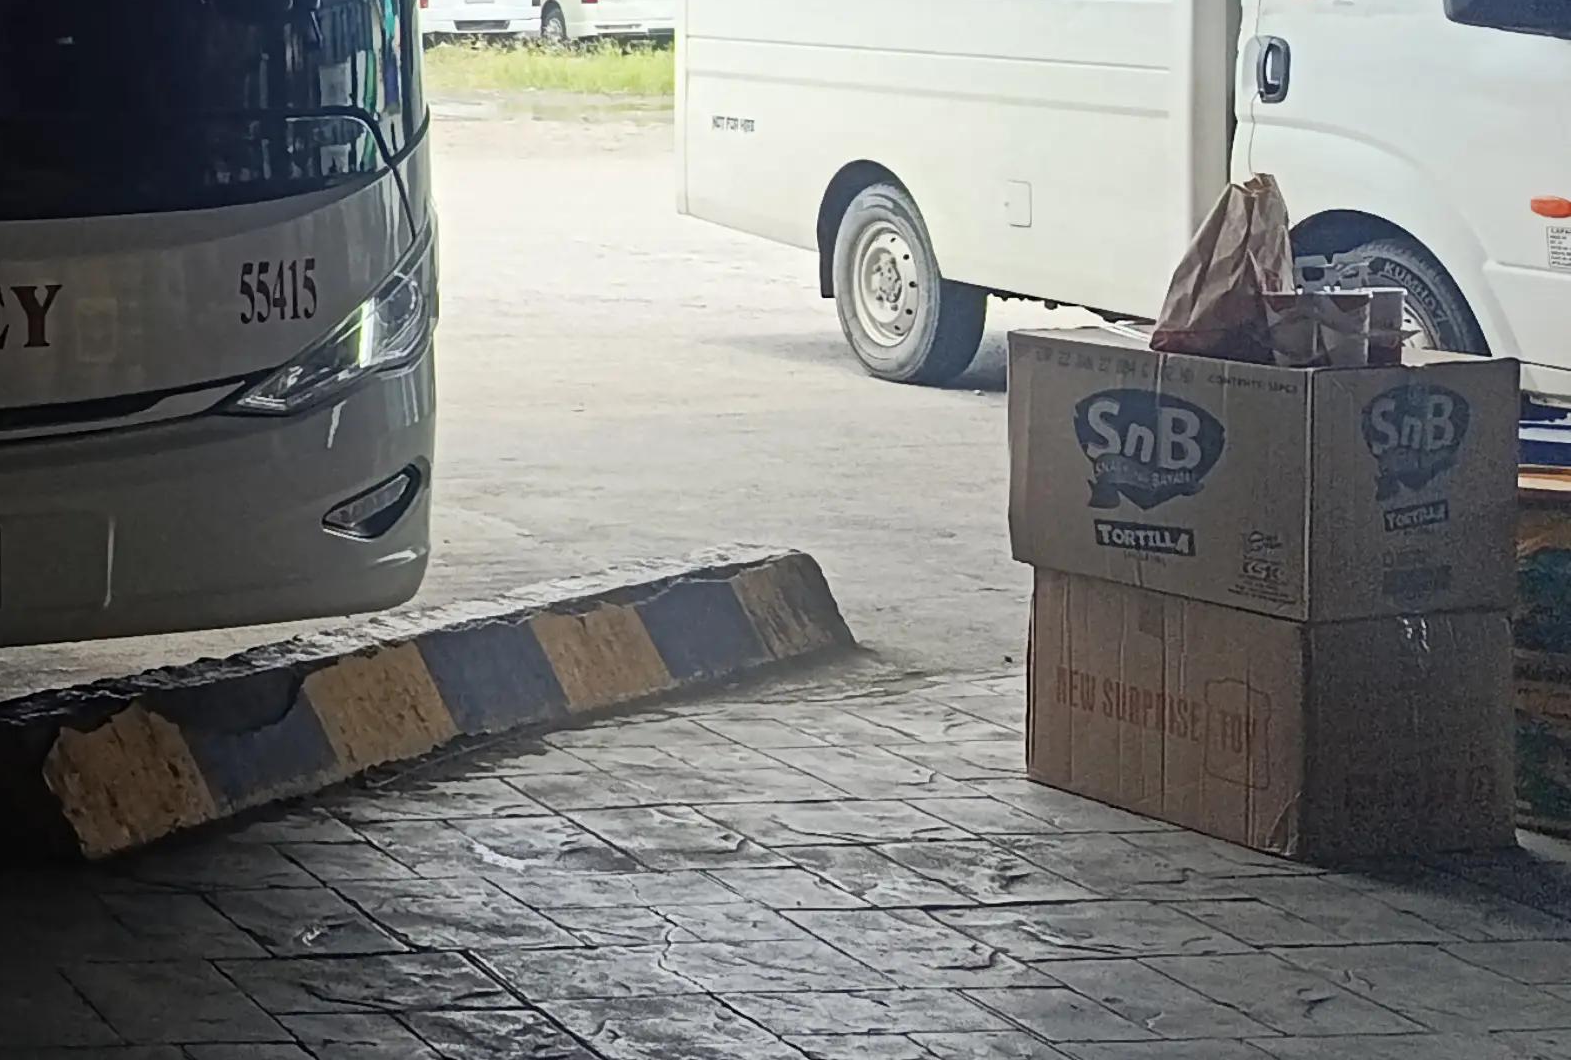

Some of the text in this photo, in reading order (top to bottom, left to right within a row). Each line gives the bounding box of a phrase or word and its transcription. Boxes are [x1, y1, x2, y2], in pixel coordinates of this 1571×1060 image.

[239, 258, 319, 325] 55415
[1087, 399, 1202, 471] SnB
[1370, 394, 1456, 455] SnB
[1097, 523, 1191, 555] TORTILLA
[1055, 665, 1097, 713] NEW
[1102, 678, 1201, 742] SURPRISE
